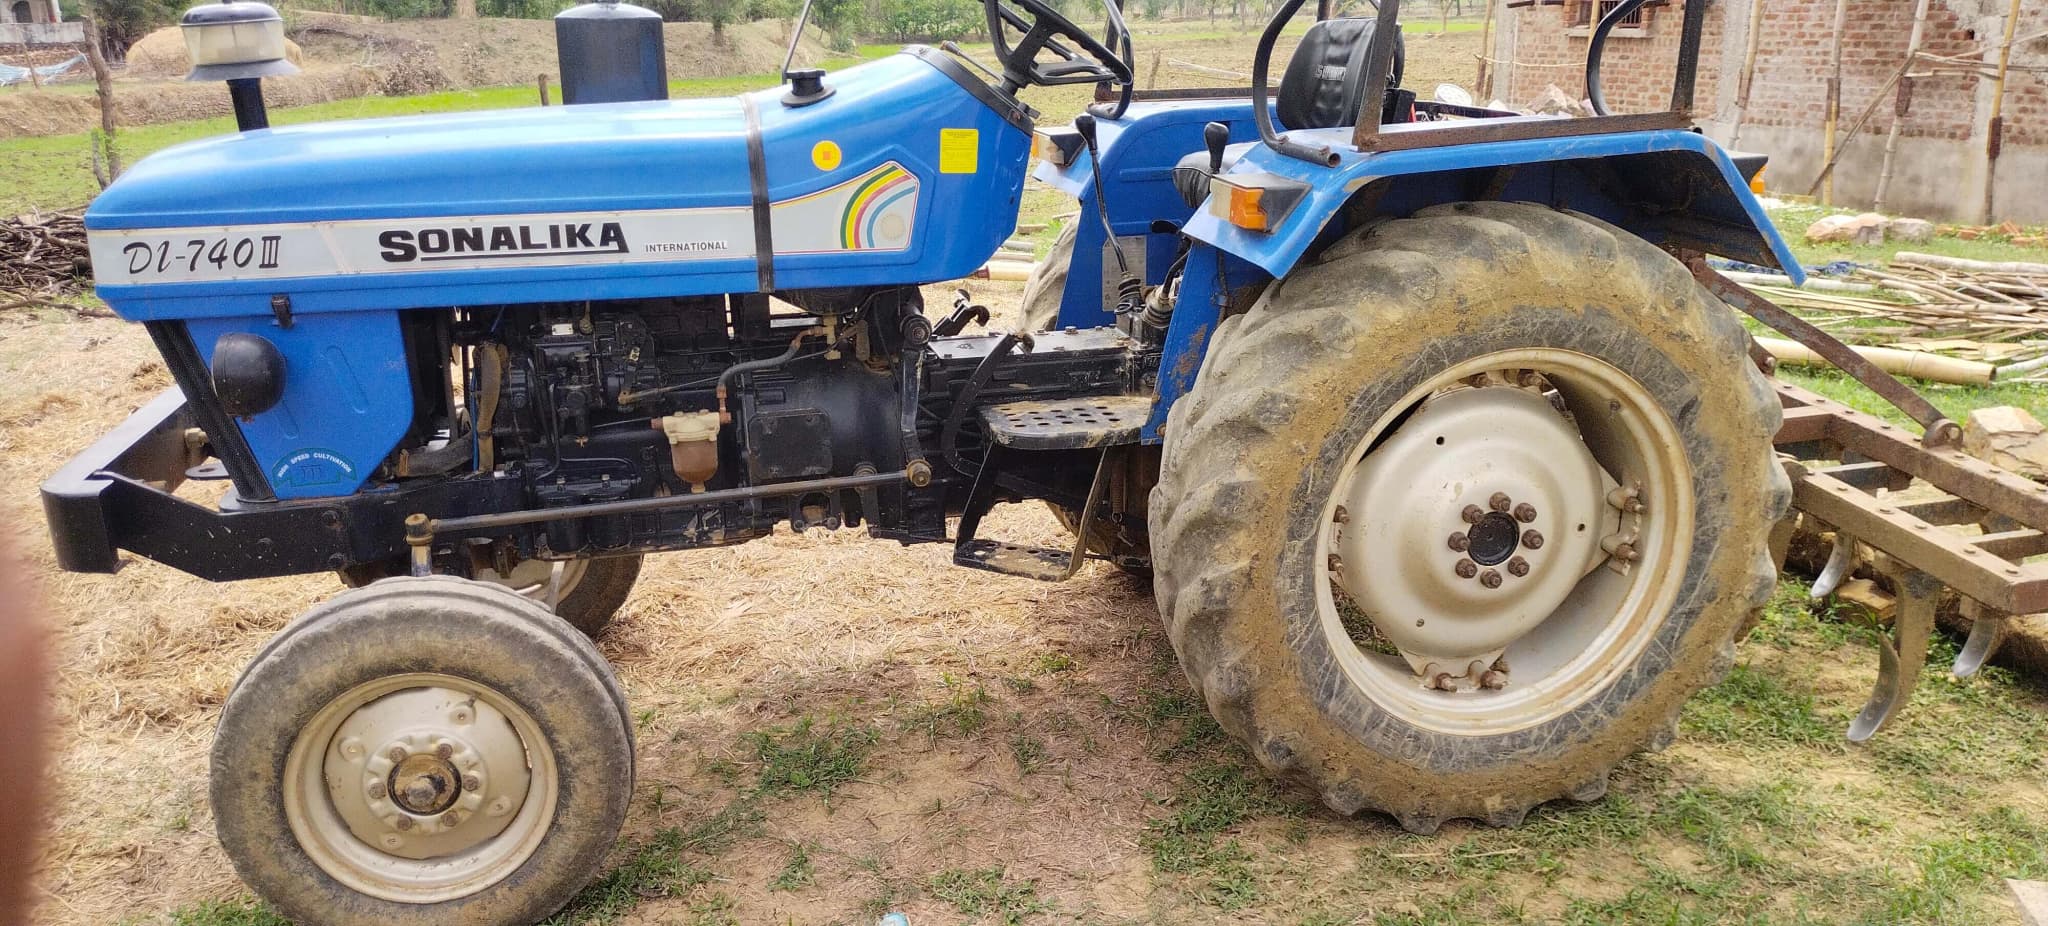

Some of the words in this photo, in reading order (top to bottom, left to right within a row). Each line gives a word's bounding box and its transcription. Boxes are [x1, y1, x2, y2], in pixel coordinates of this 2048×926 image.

[379, 222, 629, 263] SONALIKA
[645, 241, 728, 253] INTERNATIONAL
[313, 452, 352, 473] CULTIVATION
